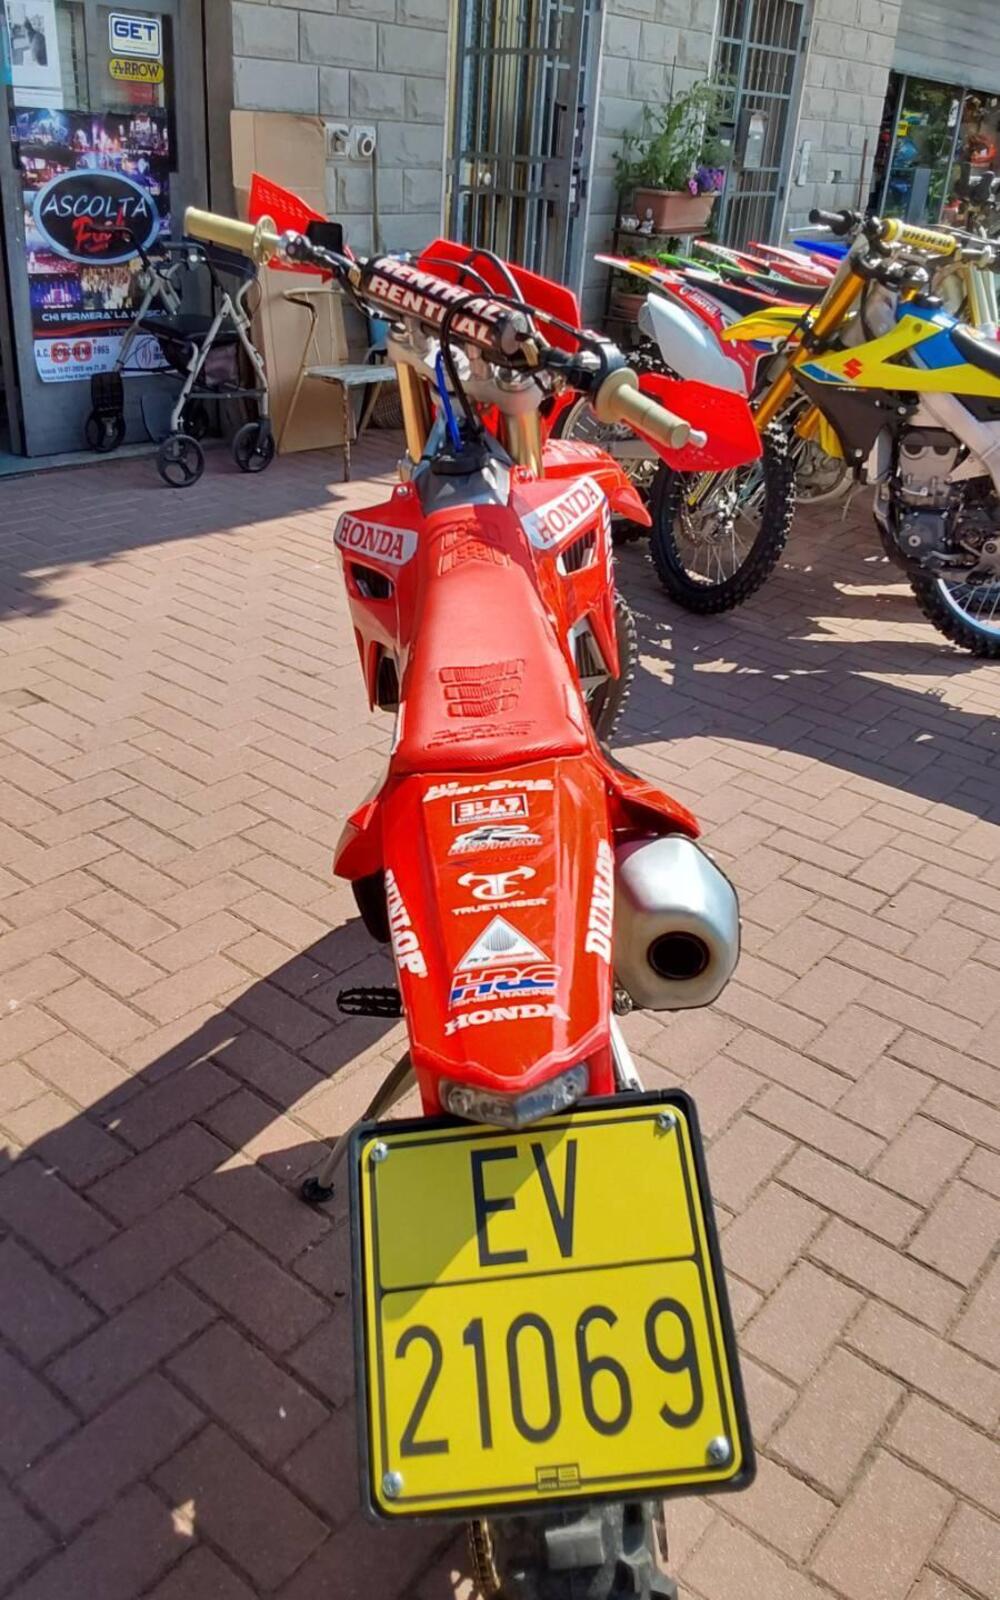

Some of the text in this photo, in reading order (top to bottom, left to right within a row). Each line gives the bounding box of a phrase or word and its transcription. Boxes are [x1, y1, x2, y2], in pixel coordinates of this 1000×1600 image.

[114, 20, 157, 42] GET
[114, 60, 160, 78] ARROW
[42, 194, 148, 218] ASCOLTA
[373, 257, 502, 323] RENTHAL
[42, 312, 60, 322] CHI
[114, 310, 129, 319] LA
[130, 309, 167, 319] MSICA
[541, 482, 599, 544] HONDA
[339, 517, 404, 560] HONDA
[451, 898, 550, 916] TRUETIMBER
[585, 838, 615, 965] DUNLOP
[449, 964, 562, 1003] HRC
[444, 1003, 571, 1036] HONDA
[470, 1138, 578, 1268] EV
[394, 1296, 704, 1458] 21069
